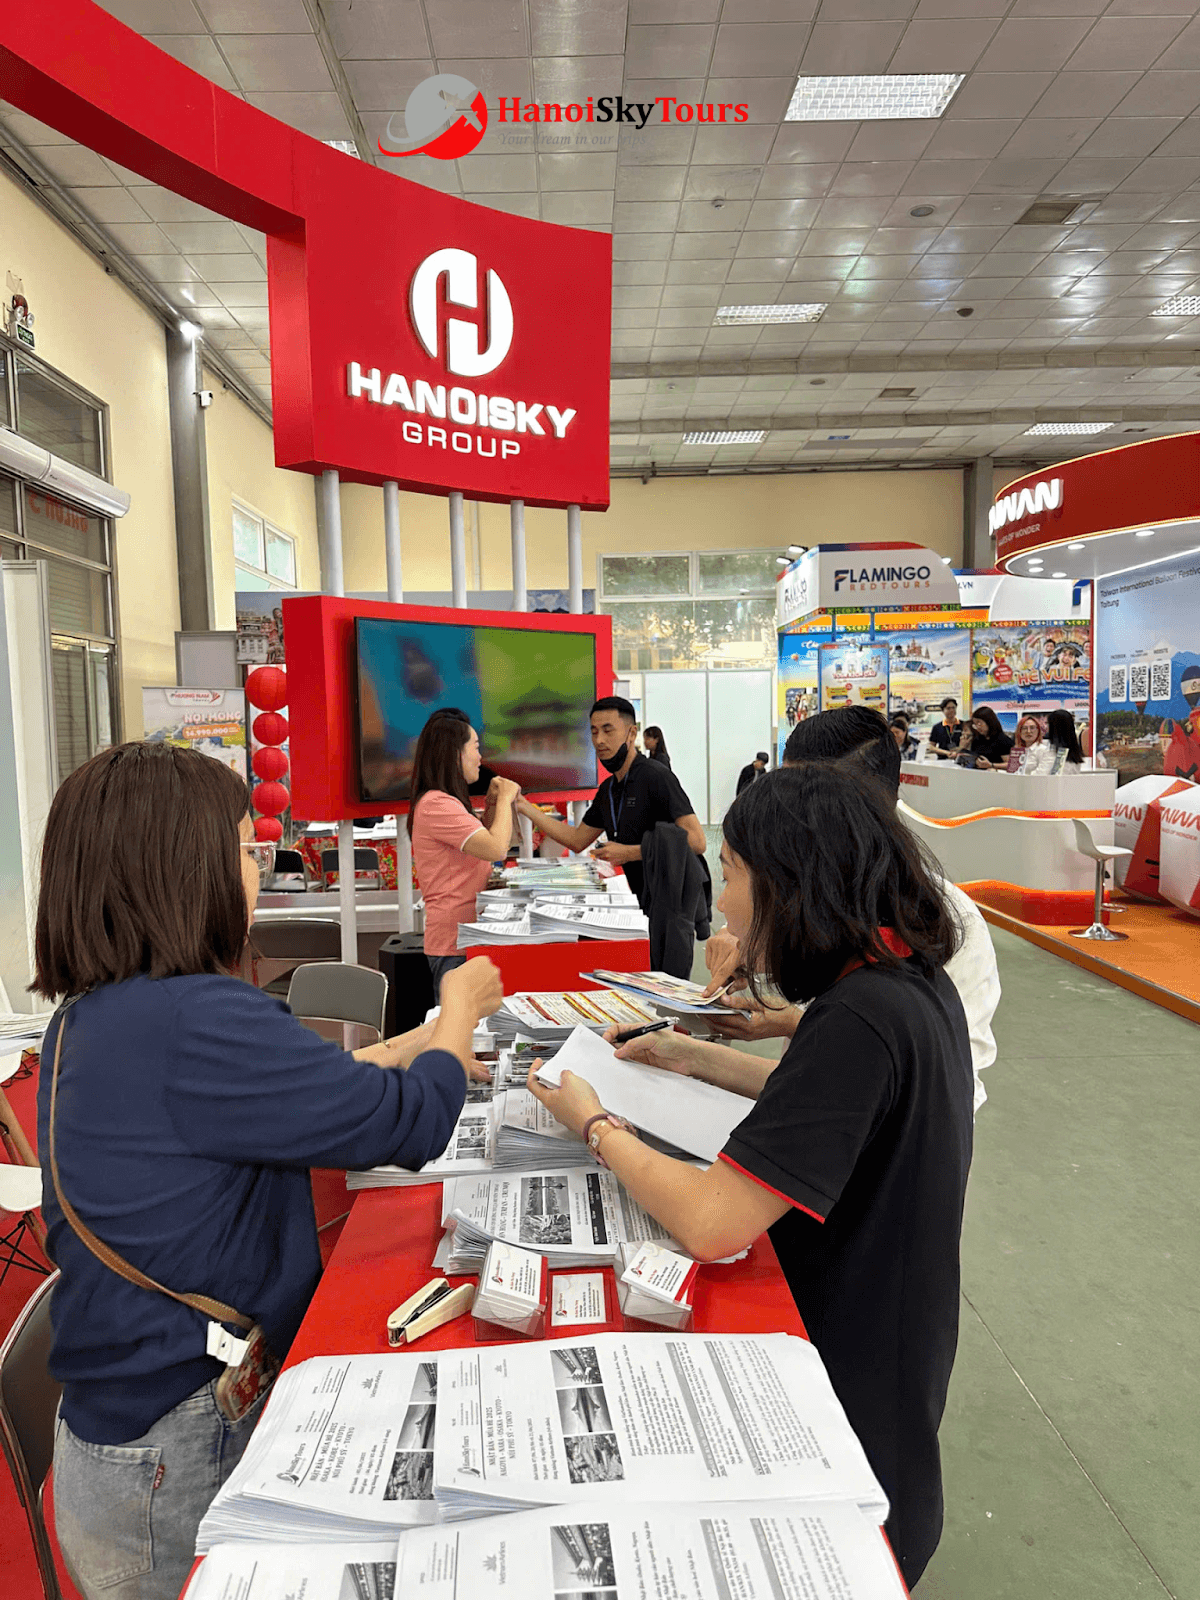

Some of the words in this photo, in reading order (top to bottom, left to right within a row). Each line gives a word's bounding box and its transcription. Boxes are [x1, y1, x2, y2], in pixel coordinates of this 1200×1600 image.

[348, 361, 577, 439] HANOISKY
[402, 422, 521, 460] GROUP
[989, 478, 1062, 536] AIWAN
[1015, 523, 1041, 538] WONDER
[834, 565, 931, 592] FLAMINGO
[850, 581, 931, 591] REDTOURS
[1100, 588, 1119, 598] Taiwan
[1119, 577, 1155, 593] International
[1100, 598, 1120, 609] Taitung
[485, 1407, 494, 1418] 2025
